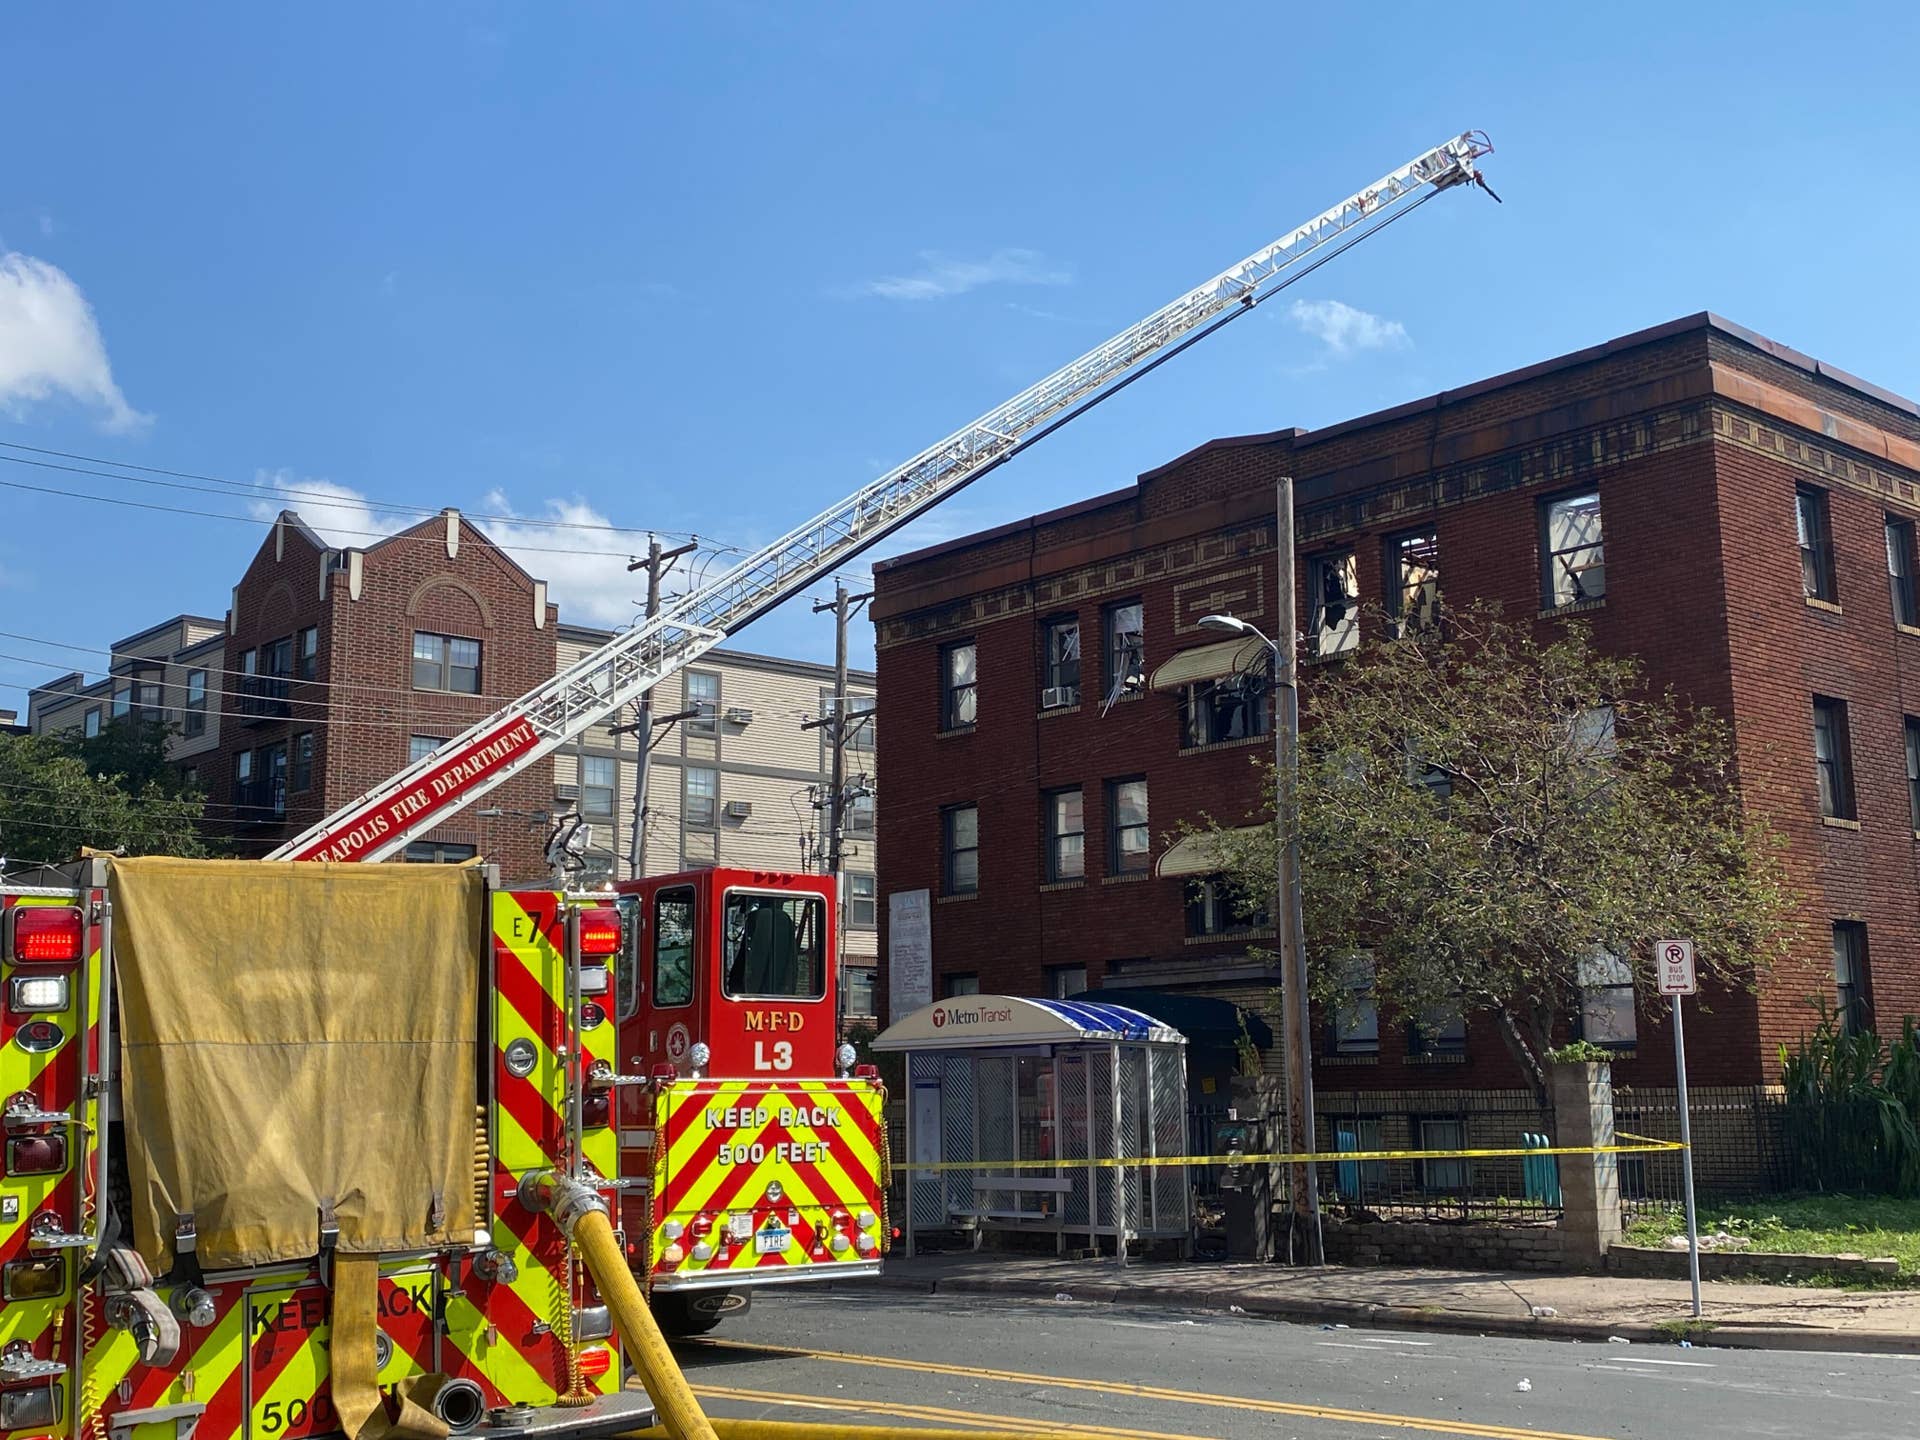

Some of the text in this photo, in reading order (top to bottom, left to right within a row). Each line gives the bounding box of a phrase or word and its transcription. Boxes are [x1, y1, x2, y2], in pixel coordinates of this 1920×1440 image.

[308, 723, 533, 862] EAPOLIS FIRE DEPARTMENT
[1668, 974, 1685, 982] STOP
[947, 1009, 979, 1025] Metro
[978, 1006, 1013, 1023] Transit
[754, 1041, 793, 1071] L3
[706, 1106, 841, 1129] KEEP BACK
[718, 1141, 831, 1165] 500 FEET
[764, 1234, 785, 1248] FIRE
[252, 1284, 432, 1334] KEE ACK
